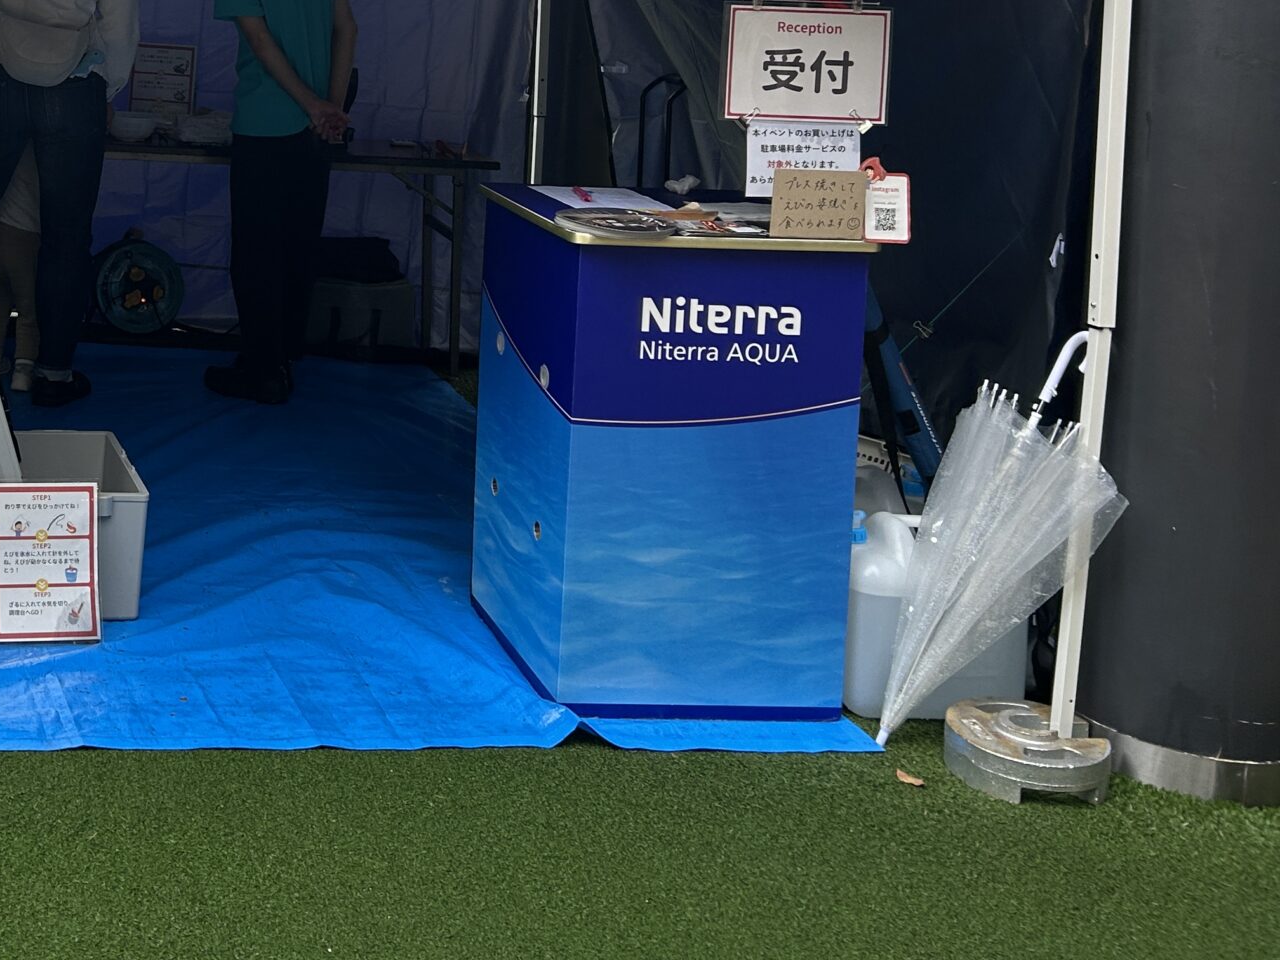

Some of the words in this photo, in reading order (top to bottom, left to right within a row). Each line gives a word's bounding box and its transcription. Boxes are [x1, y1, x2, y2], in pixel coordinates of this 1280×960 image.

[777, 21, 842, 36] Reception
[762, 48, 854, 95] 受付
[641, 296, 802, 336] Niterra
[639, 340, 719, 361] Niterra
[726, 342, 799, 365] AQUA
